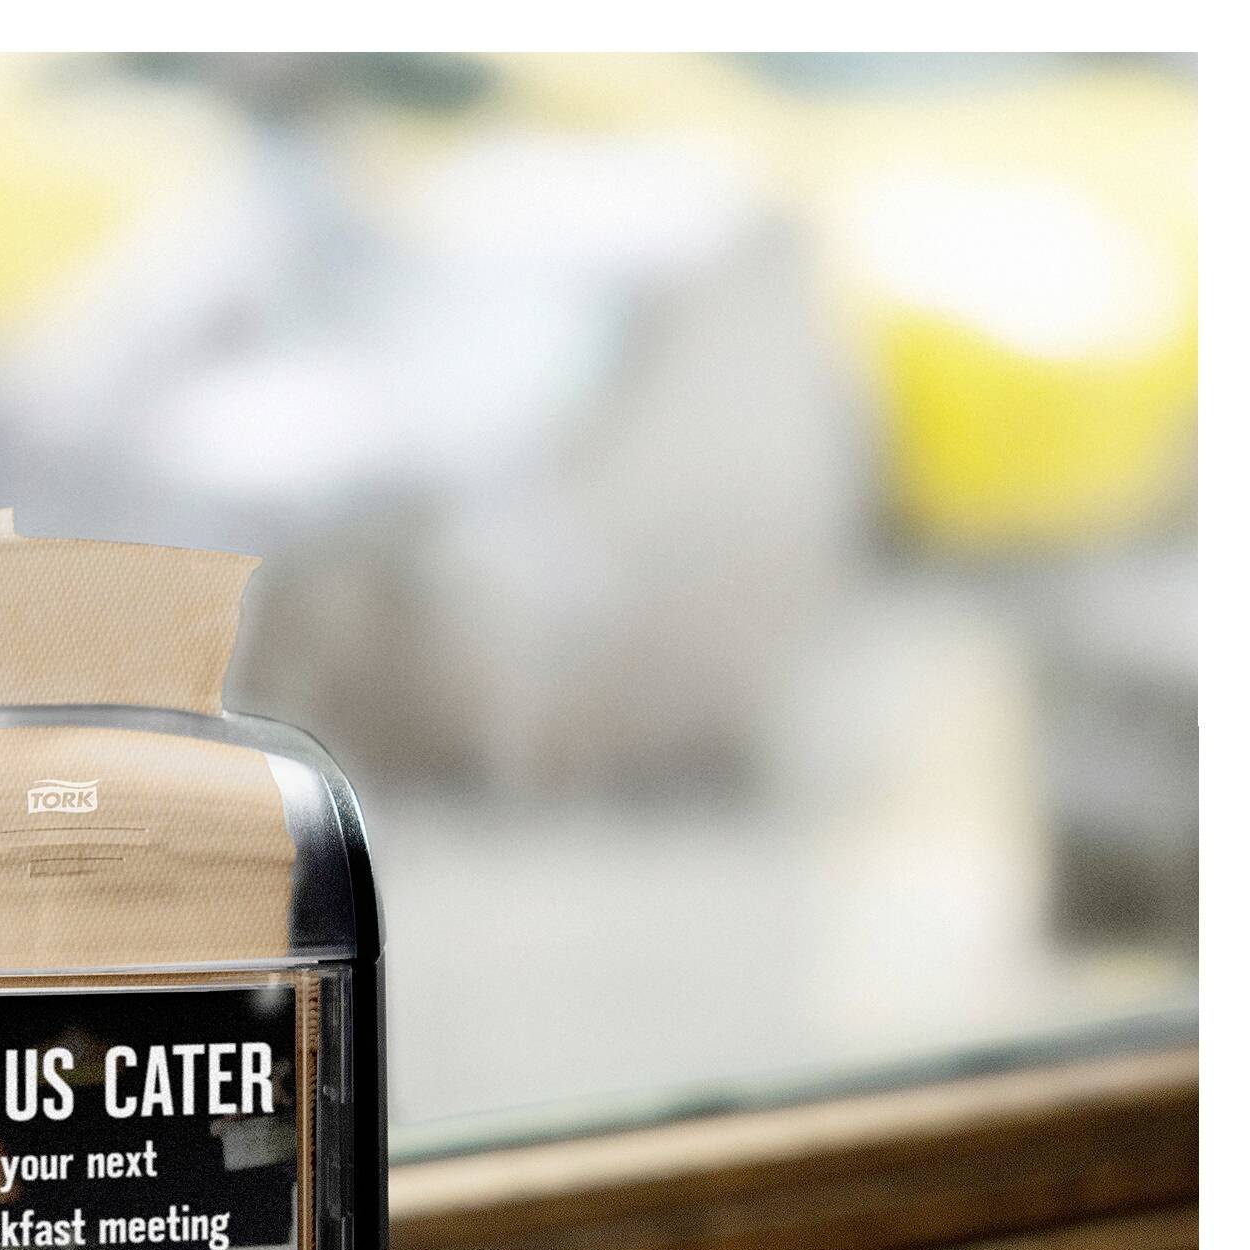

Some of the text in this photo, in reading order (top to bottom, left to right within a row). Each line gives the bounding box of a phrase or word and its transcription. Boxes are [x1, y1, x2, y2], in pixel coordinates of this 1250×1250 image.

[30, 790, 95, 810] TORK
[5, 1047, 75, 1122] US
[104, 1042, 274, 1118] CATER
[0, 1140, 158, 1194] your next
